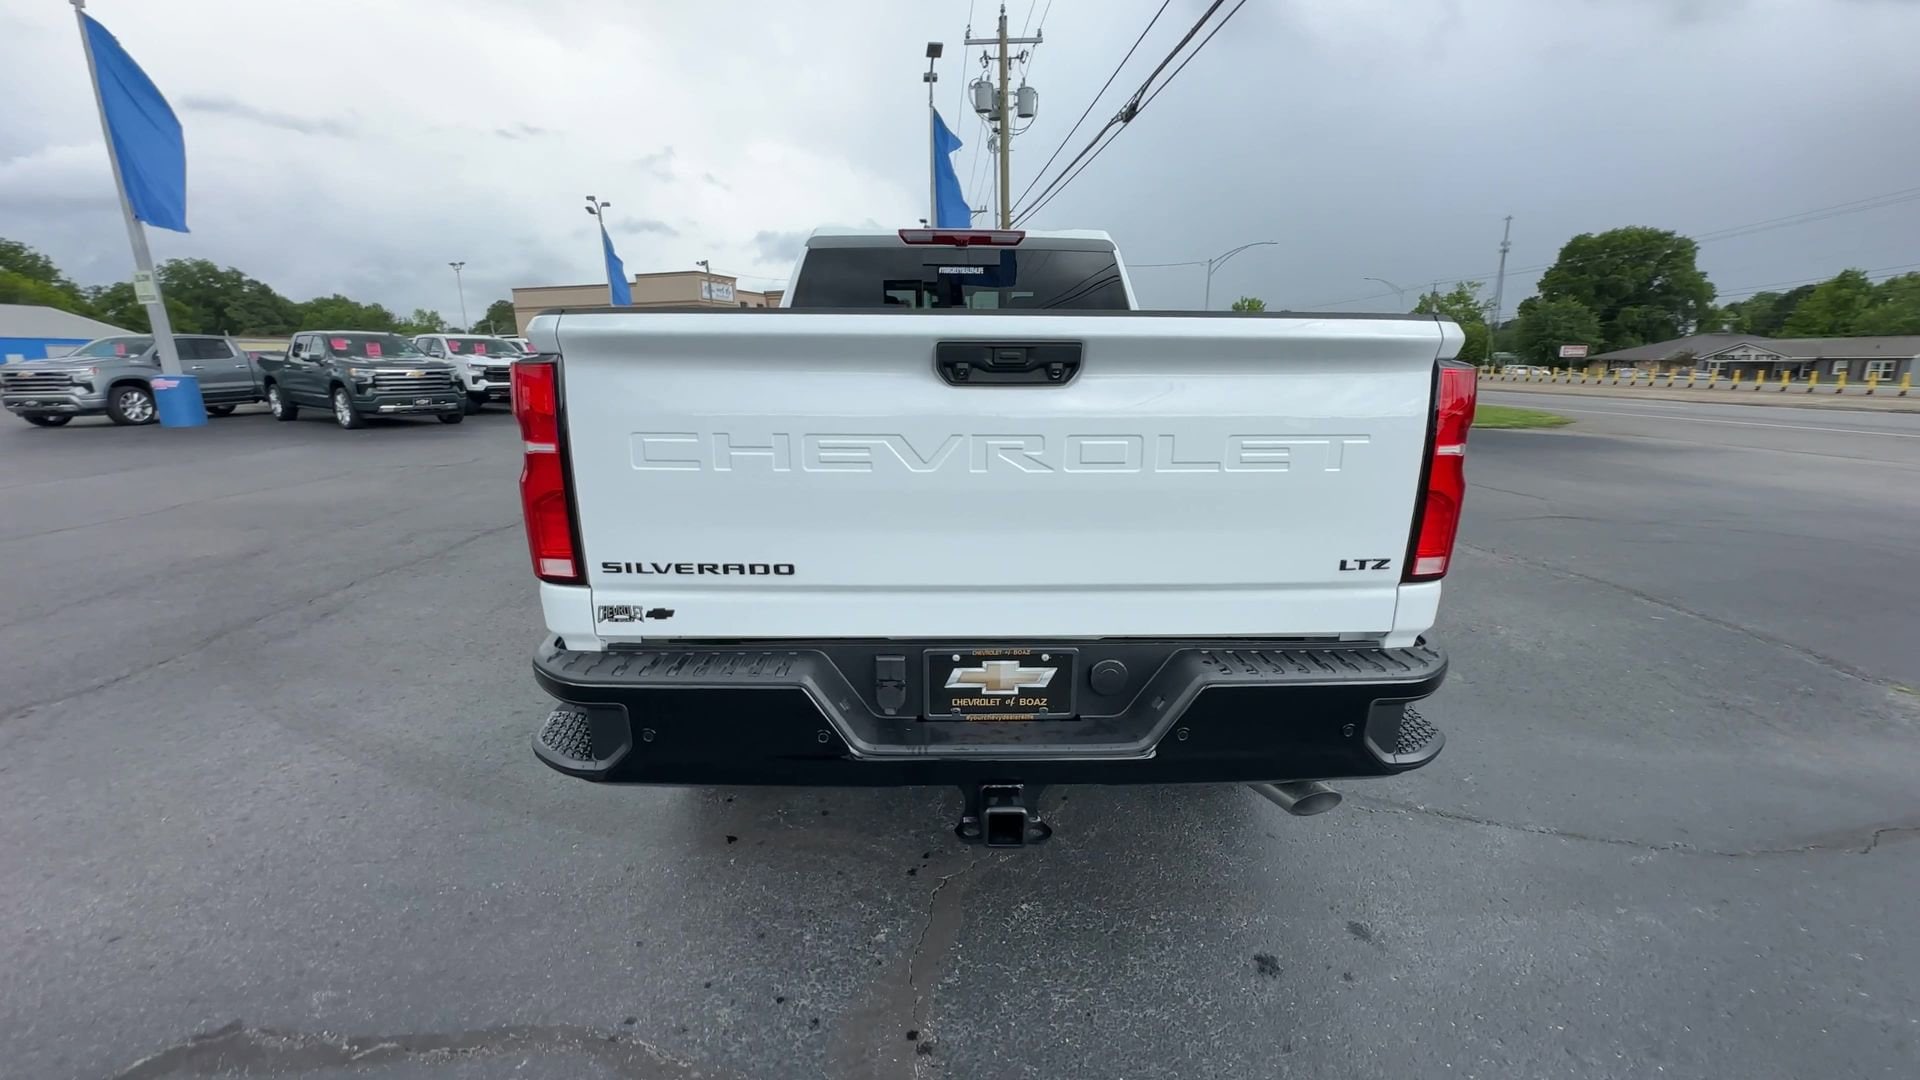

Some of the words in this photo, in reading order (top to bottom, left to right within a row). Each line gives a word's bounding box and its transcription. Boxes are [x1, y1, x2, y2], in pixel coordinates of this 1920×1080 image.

[630, 431, 1371, 474] CHEVROLET
[601, 562, 795, 576] SILVERADO
[1339, 558, 1391, 571] LTZ
[951, 698, 1001, 706] CHEVROLET
[1019, 698, 1048, 706] BOAZ
